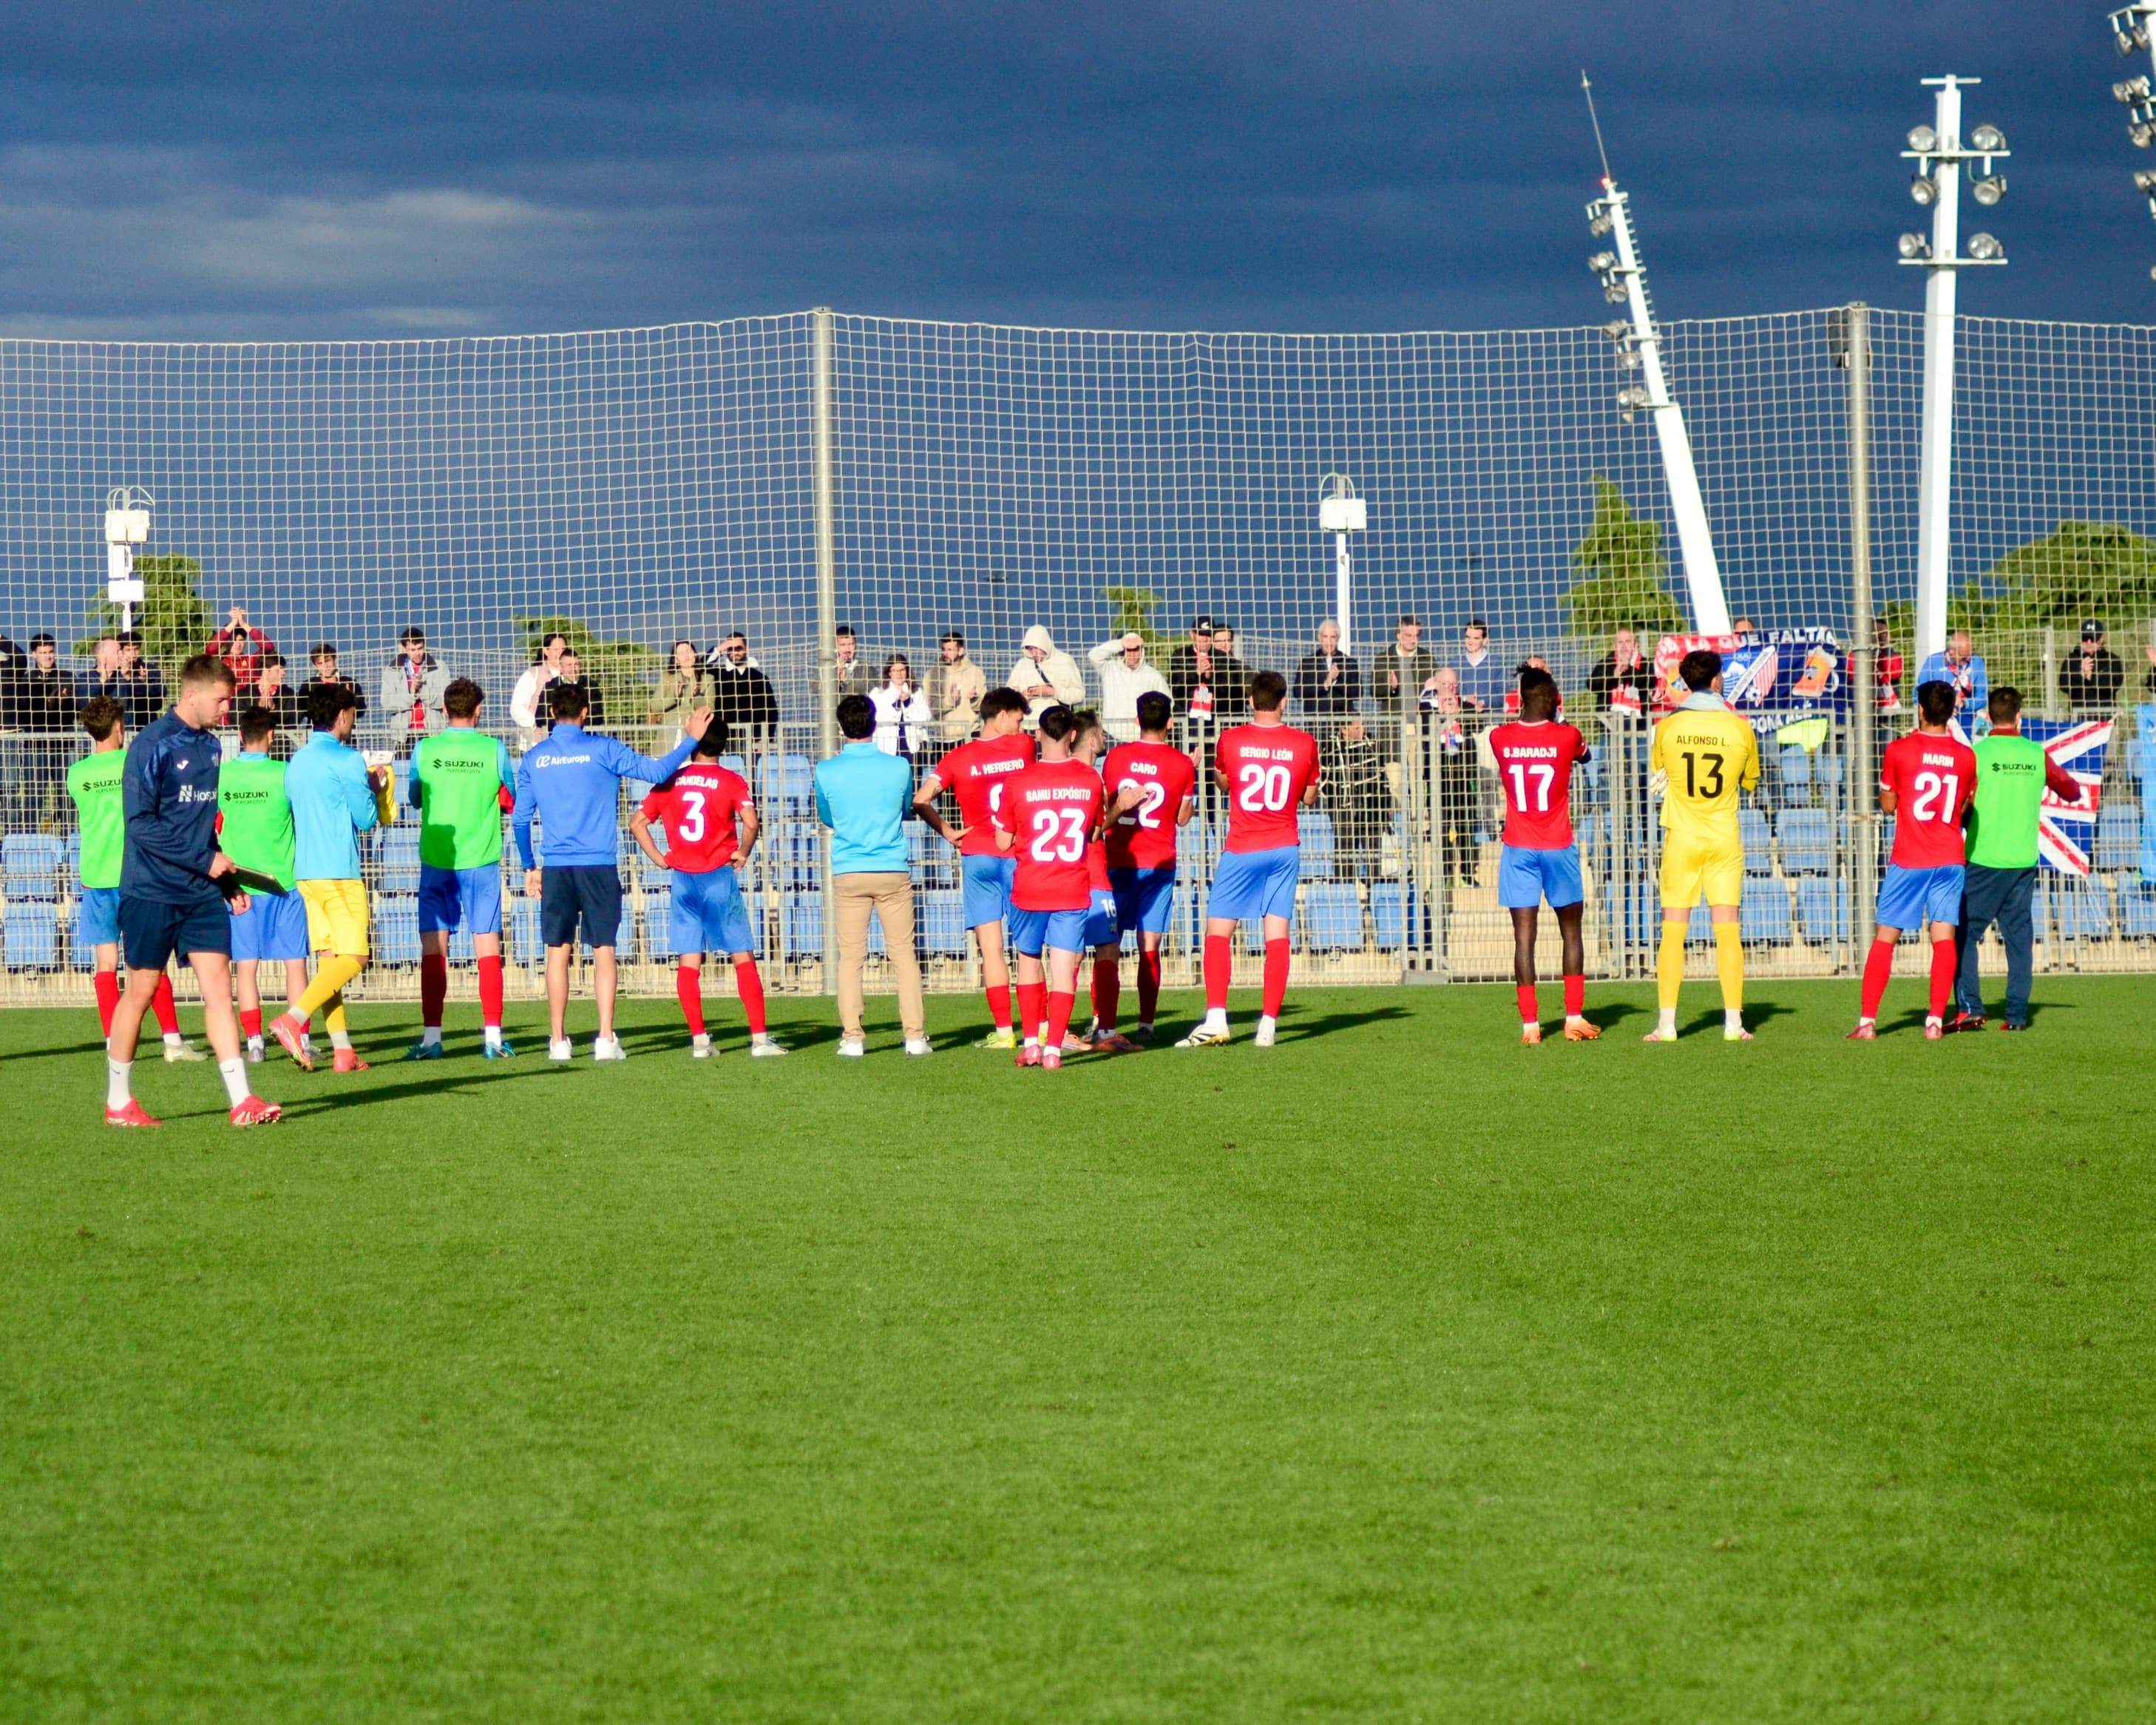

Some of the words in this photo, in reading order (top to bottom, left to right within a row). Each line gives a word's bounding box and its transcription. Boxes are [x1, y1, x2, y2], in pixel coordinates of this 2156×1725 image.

[1718, 634, 1760, 649] QUE
[1676, 735, 1718, 746] ALFONSO
[1721, 737, 1730, 747] L.
[1240, 747, 1270, 759] SERGIO
[1272, 748, 1293, 762] LEÓN
[1503, 747, 1557, 758] S.BARADJI
[970, 765, 982, 776] A.
[983, 759, 1025, 775] HERRERO
[1130, 762, 1157, 775] CARO
[2002, 763, 2036, 771] SUZUKI
[1681, 752, 1724, 799] 13
[93, 779, 121, 788] SUZU
[1240, 764, 1291, 811] 20
[1508, 765, 1555, 812] 17
[232, 791, 268, 799] SUZUKI
[1026, 789, 1051, 802] SAMU
[1052, 786, 1091, 801] EXPÓSITO
[1913, 771, 1959, 824] 21
[679, 791, 705, 841] 3
[1031, 808, 1086, 862] 23
